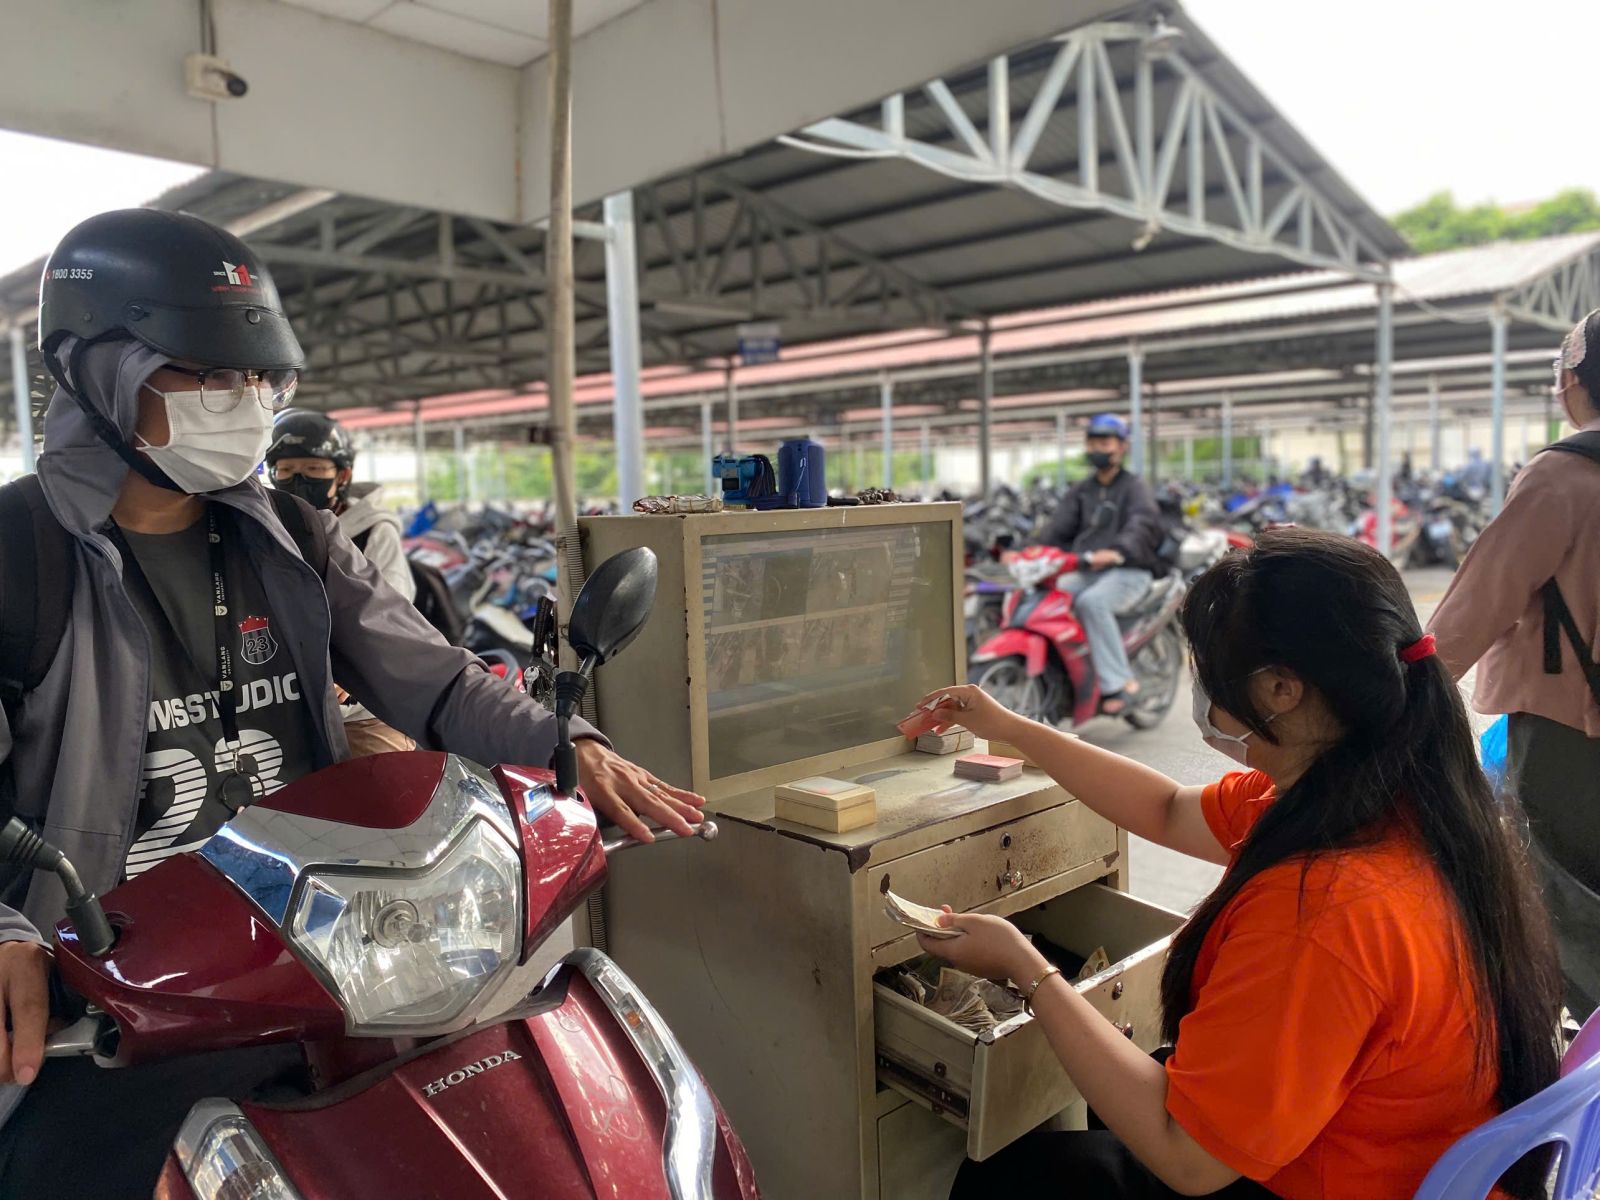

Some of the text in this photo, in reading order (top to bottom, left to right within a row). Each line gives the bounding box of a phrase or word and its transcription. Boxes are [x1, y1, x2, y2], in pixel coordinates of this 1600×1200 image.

[69, 268, 94, 280] 3355
[214, 572, 222, 604] VANLAND
[246, 635, 270, 656] 23
[421, 1049, 522, 1097] HONDA
